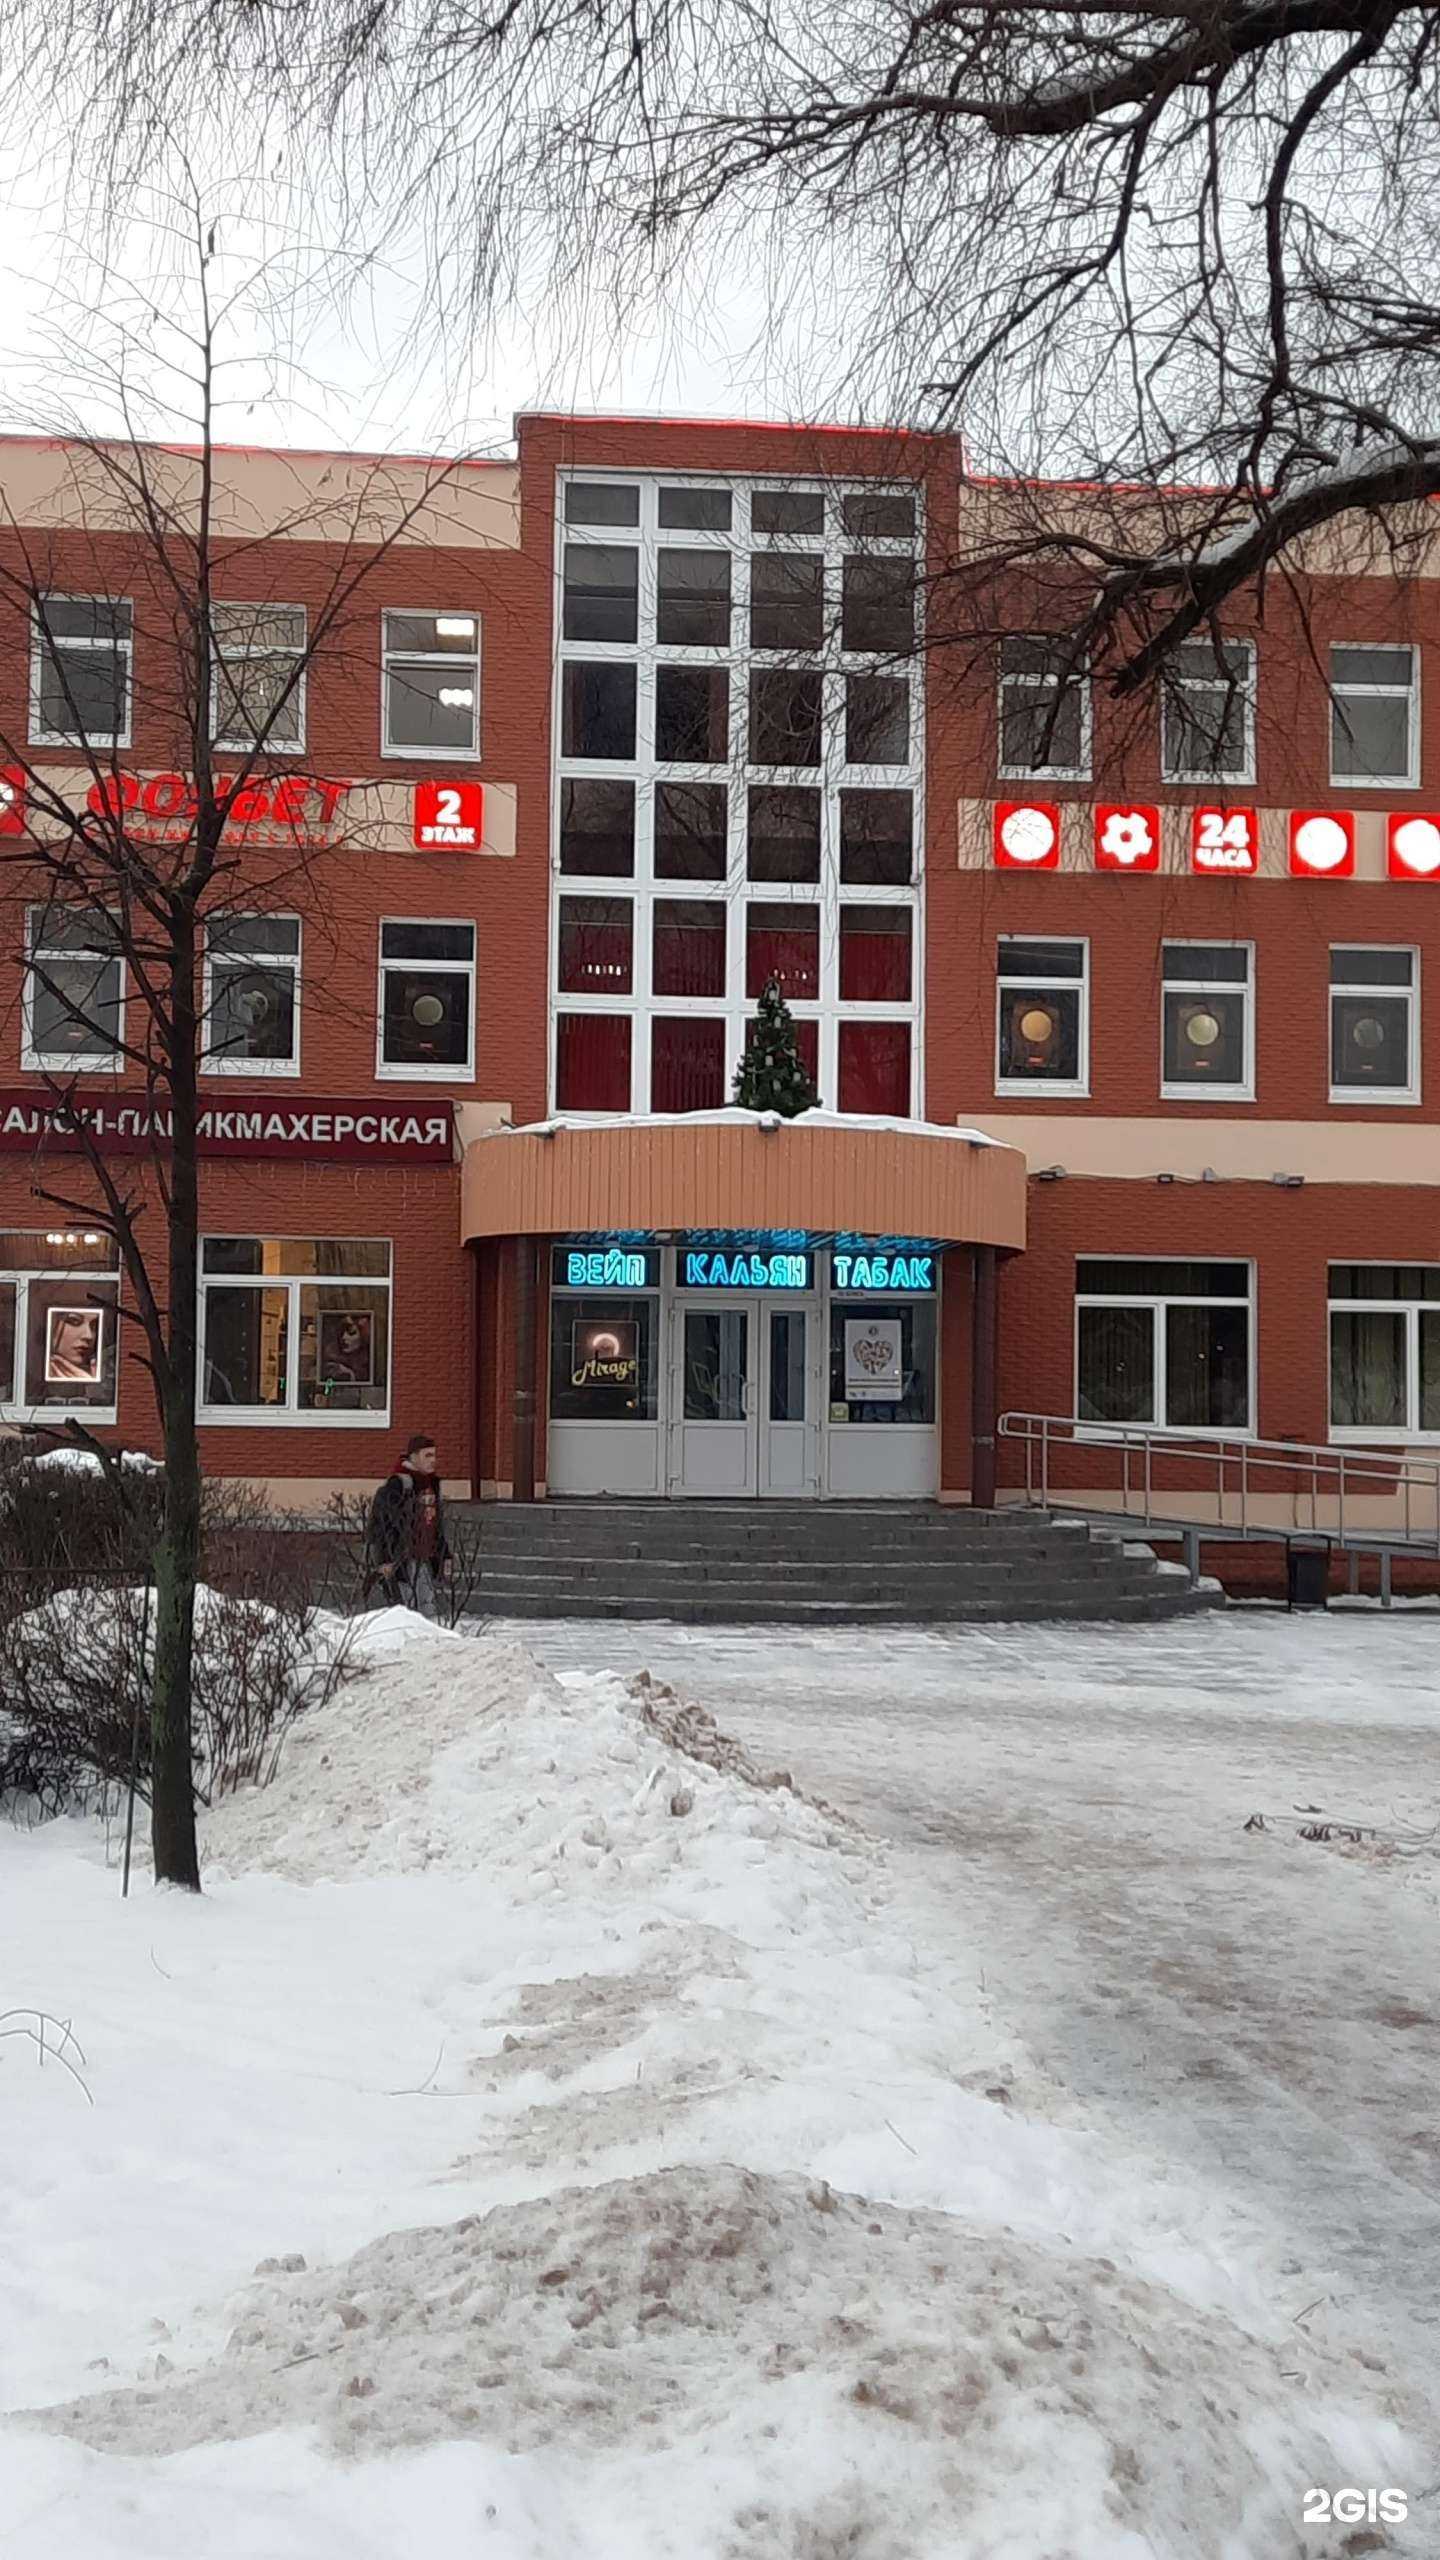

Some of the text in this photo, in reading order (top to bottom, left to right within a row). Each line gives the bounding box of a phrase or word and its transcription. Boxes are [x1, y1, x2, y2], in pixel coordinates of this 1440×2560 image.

[436, 789, 462, 824] 2
[421, 826, 475, 844] ЭТАЖ
[1200, 813, 1250, 848] 24
[1196, 847, 1253, 867] ЧАСА
[567, 1248, 932, 1289] ВЕЙП КАЛЬЯН ТАБАК
[572, 1359, 637, 1387] Mirage
